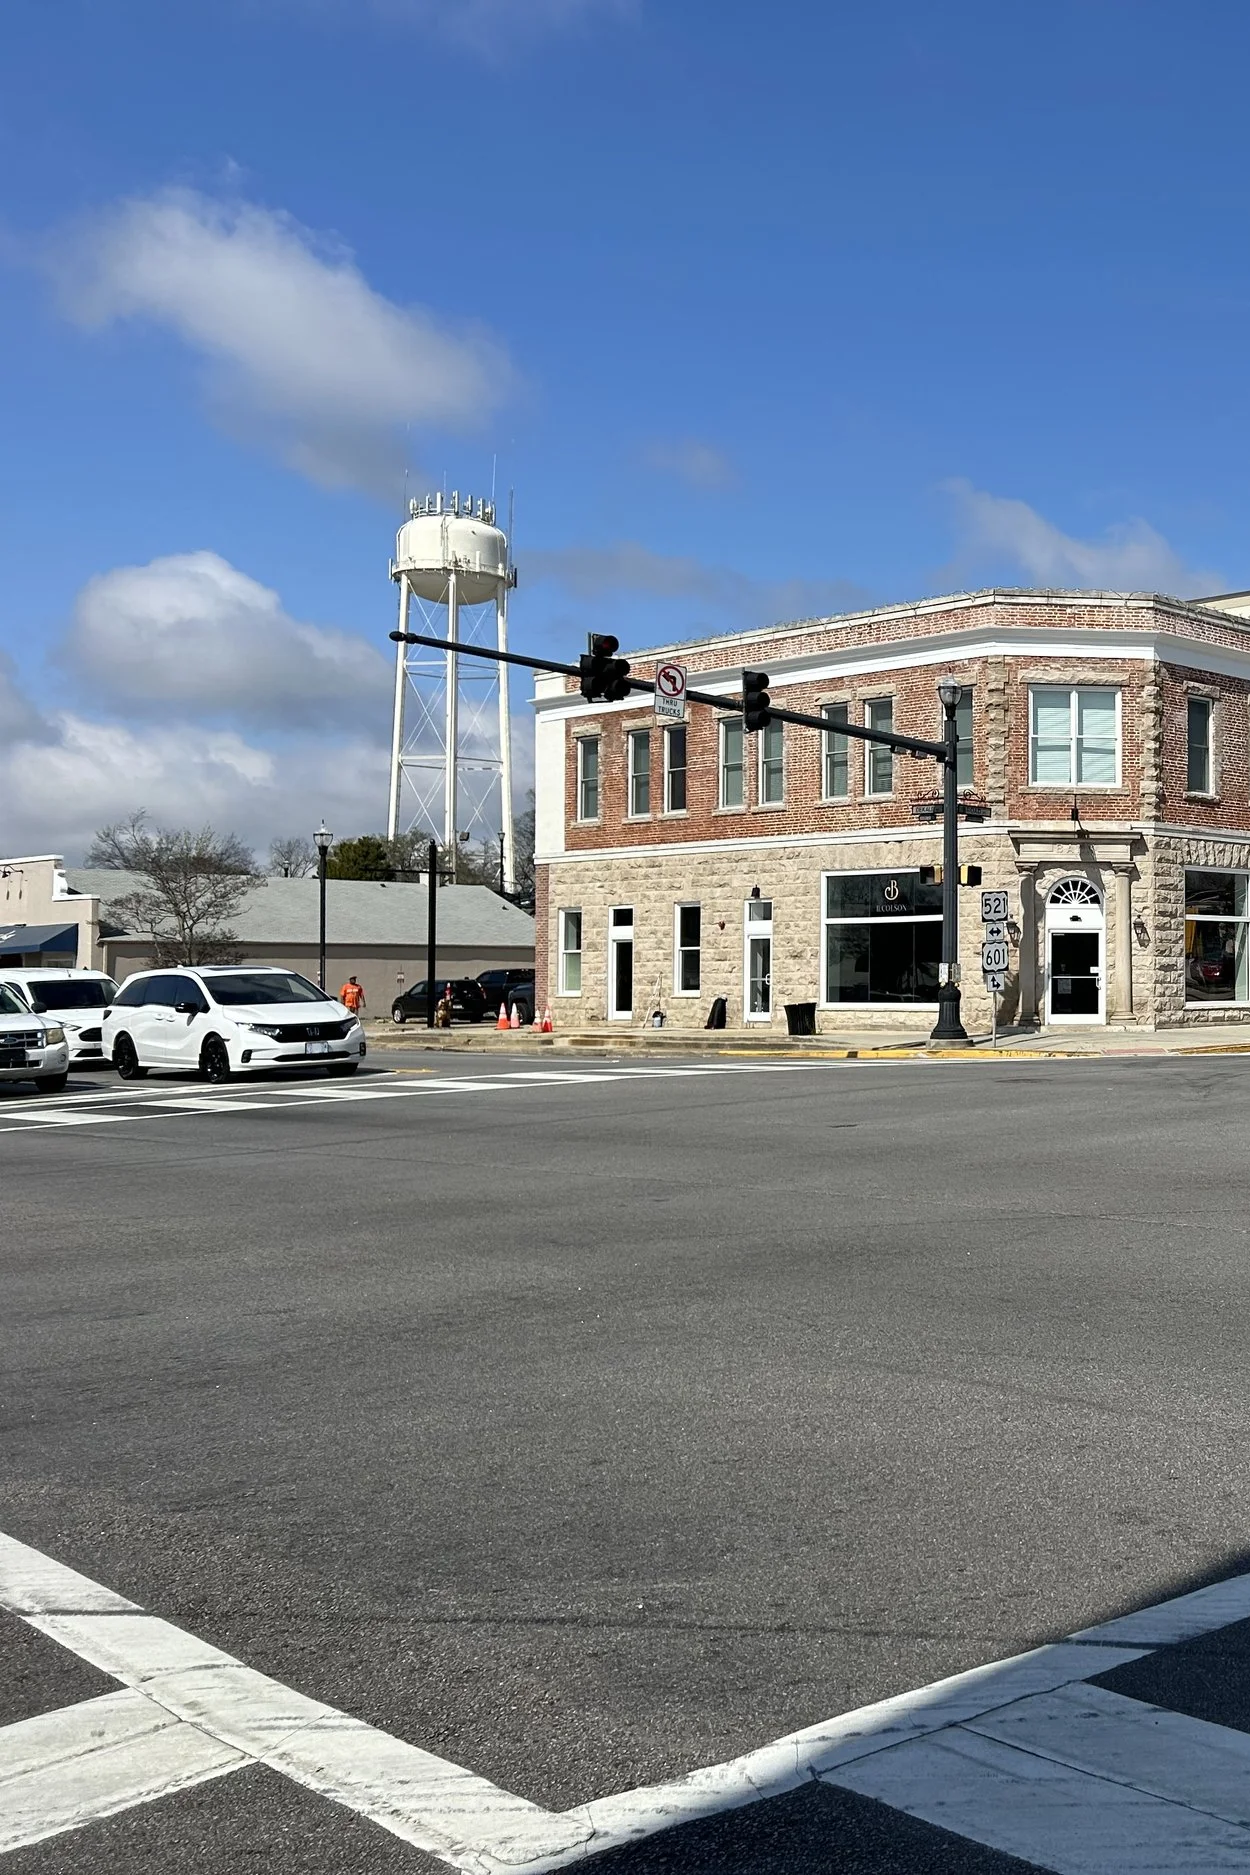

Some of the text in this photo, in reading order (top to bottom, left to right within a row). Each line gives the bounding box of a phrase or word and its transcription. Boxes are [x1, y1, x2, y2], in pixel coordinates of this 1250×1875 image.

[662, 698, 678, 707] THRU
[658, 705, 681, 716] TRUCKS
[984, 897, 1006, 915] 521
[985, 948, 1005, 966] 601
